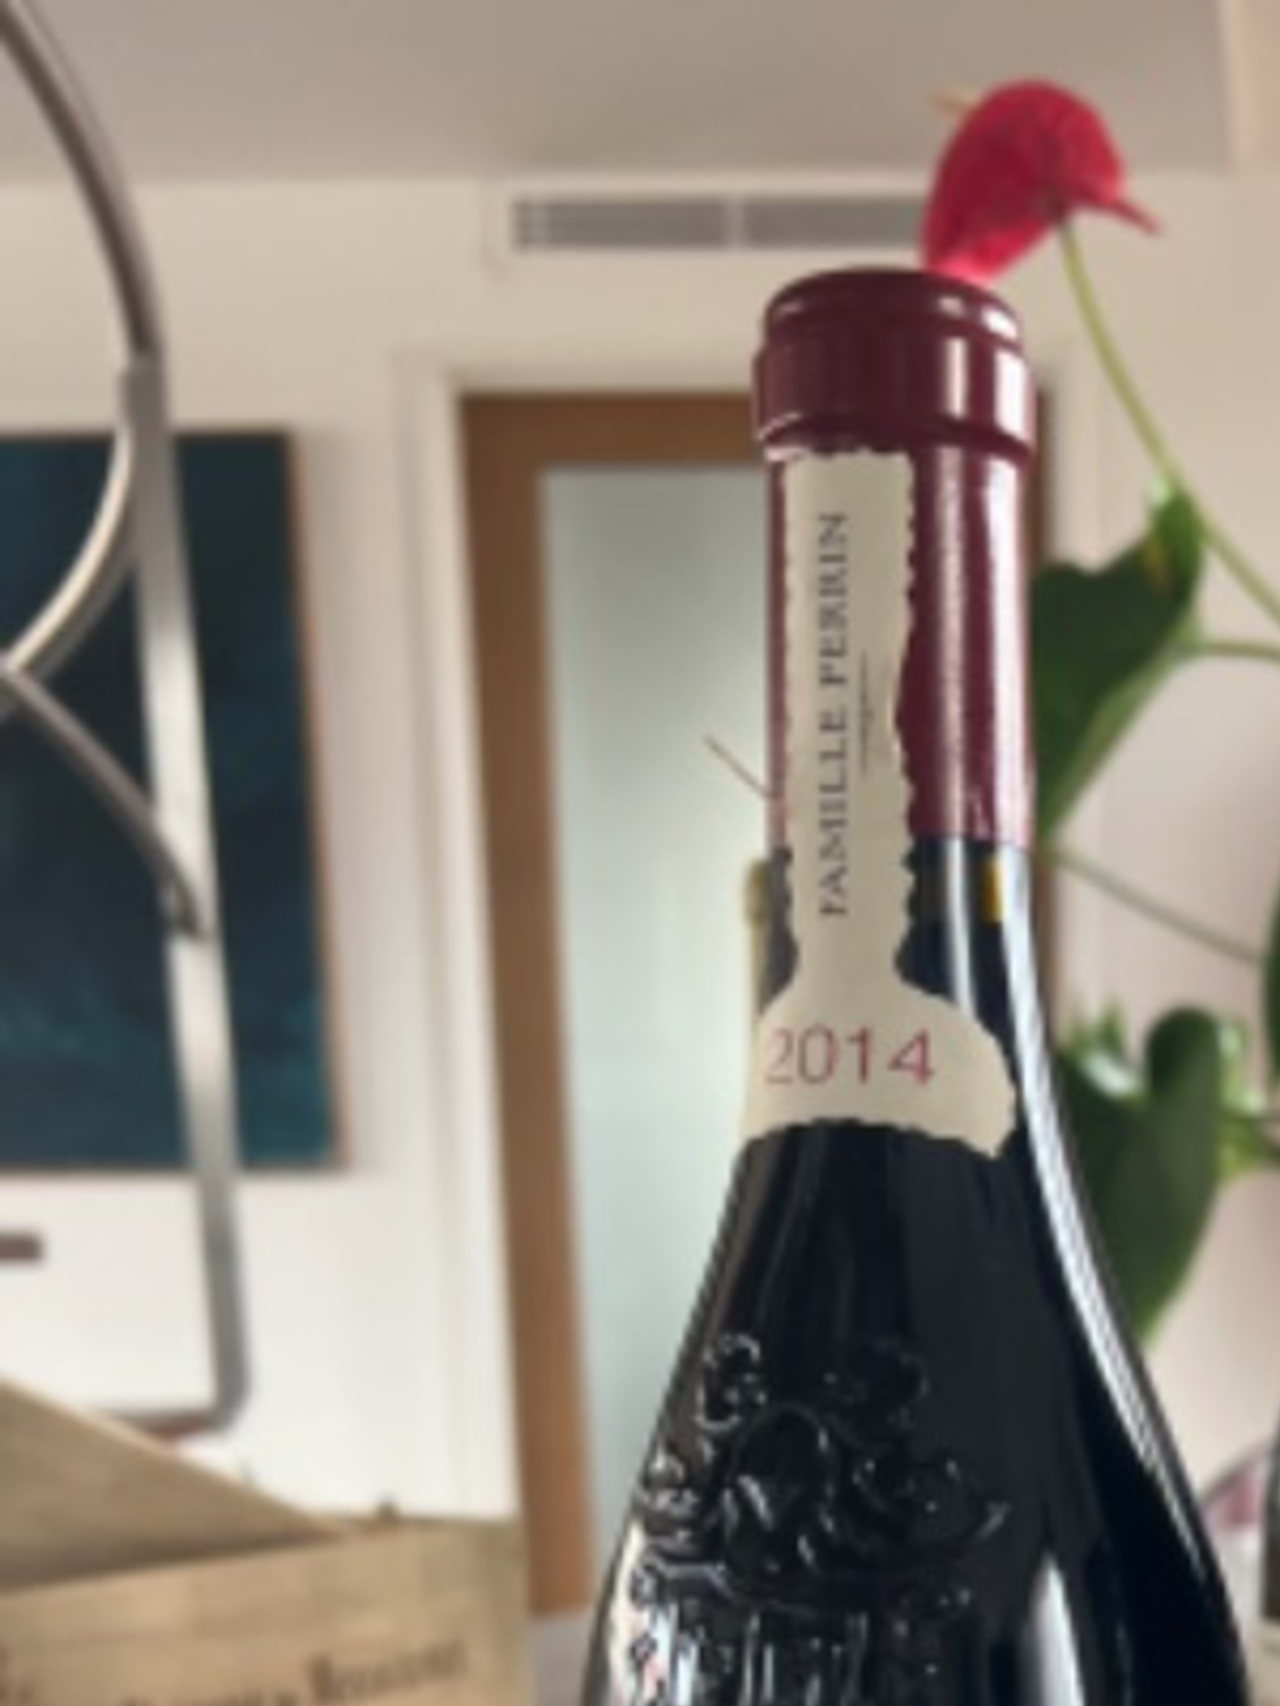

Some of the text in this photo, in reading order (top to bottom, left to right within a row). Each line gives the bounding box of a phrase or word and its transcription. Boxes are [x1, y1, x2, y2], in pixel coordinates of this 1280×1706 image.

[818, 513, 850, 919] FAMILLE PERRIN
[765, 1026, 938, 1087] 2014
